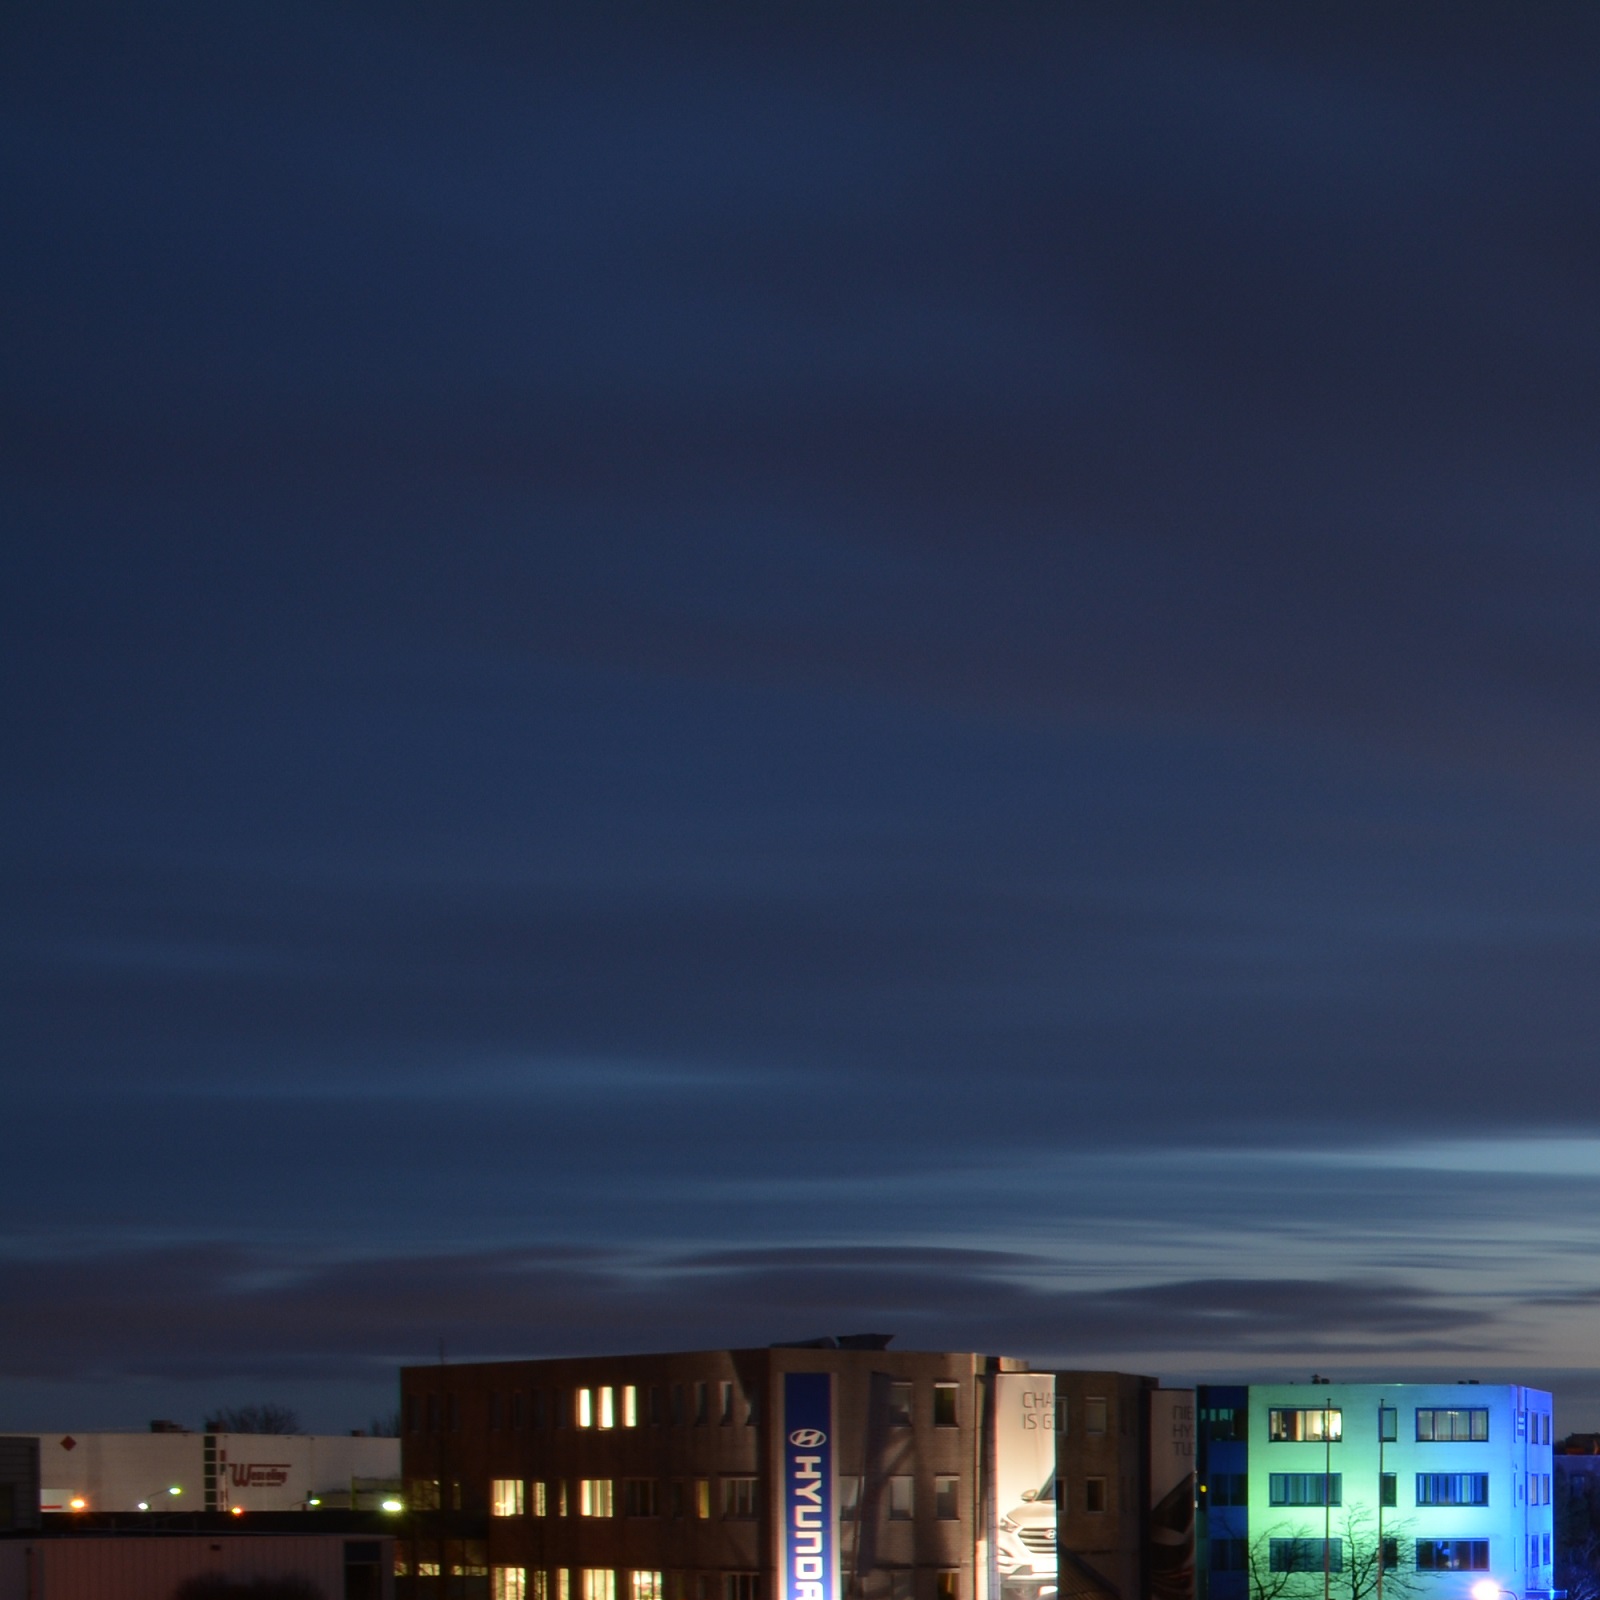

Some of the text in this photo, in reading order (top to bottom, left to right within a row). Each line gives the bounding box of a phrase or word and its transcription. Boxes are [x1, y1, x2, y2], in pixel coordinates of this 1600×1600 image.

[1023, 1391, 1055, 1408] CHA
[1023, 1413, 1055, 1430] IS G
[1172, 1424, 1194, 1438] HY
[1172, 1441, 1195, 1456] TU
